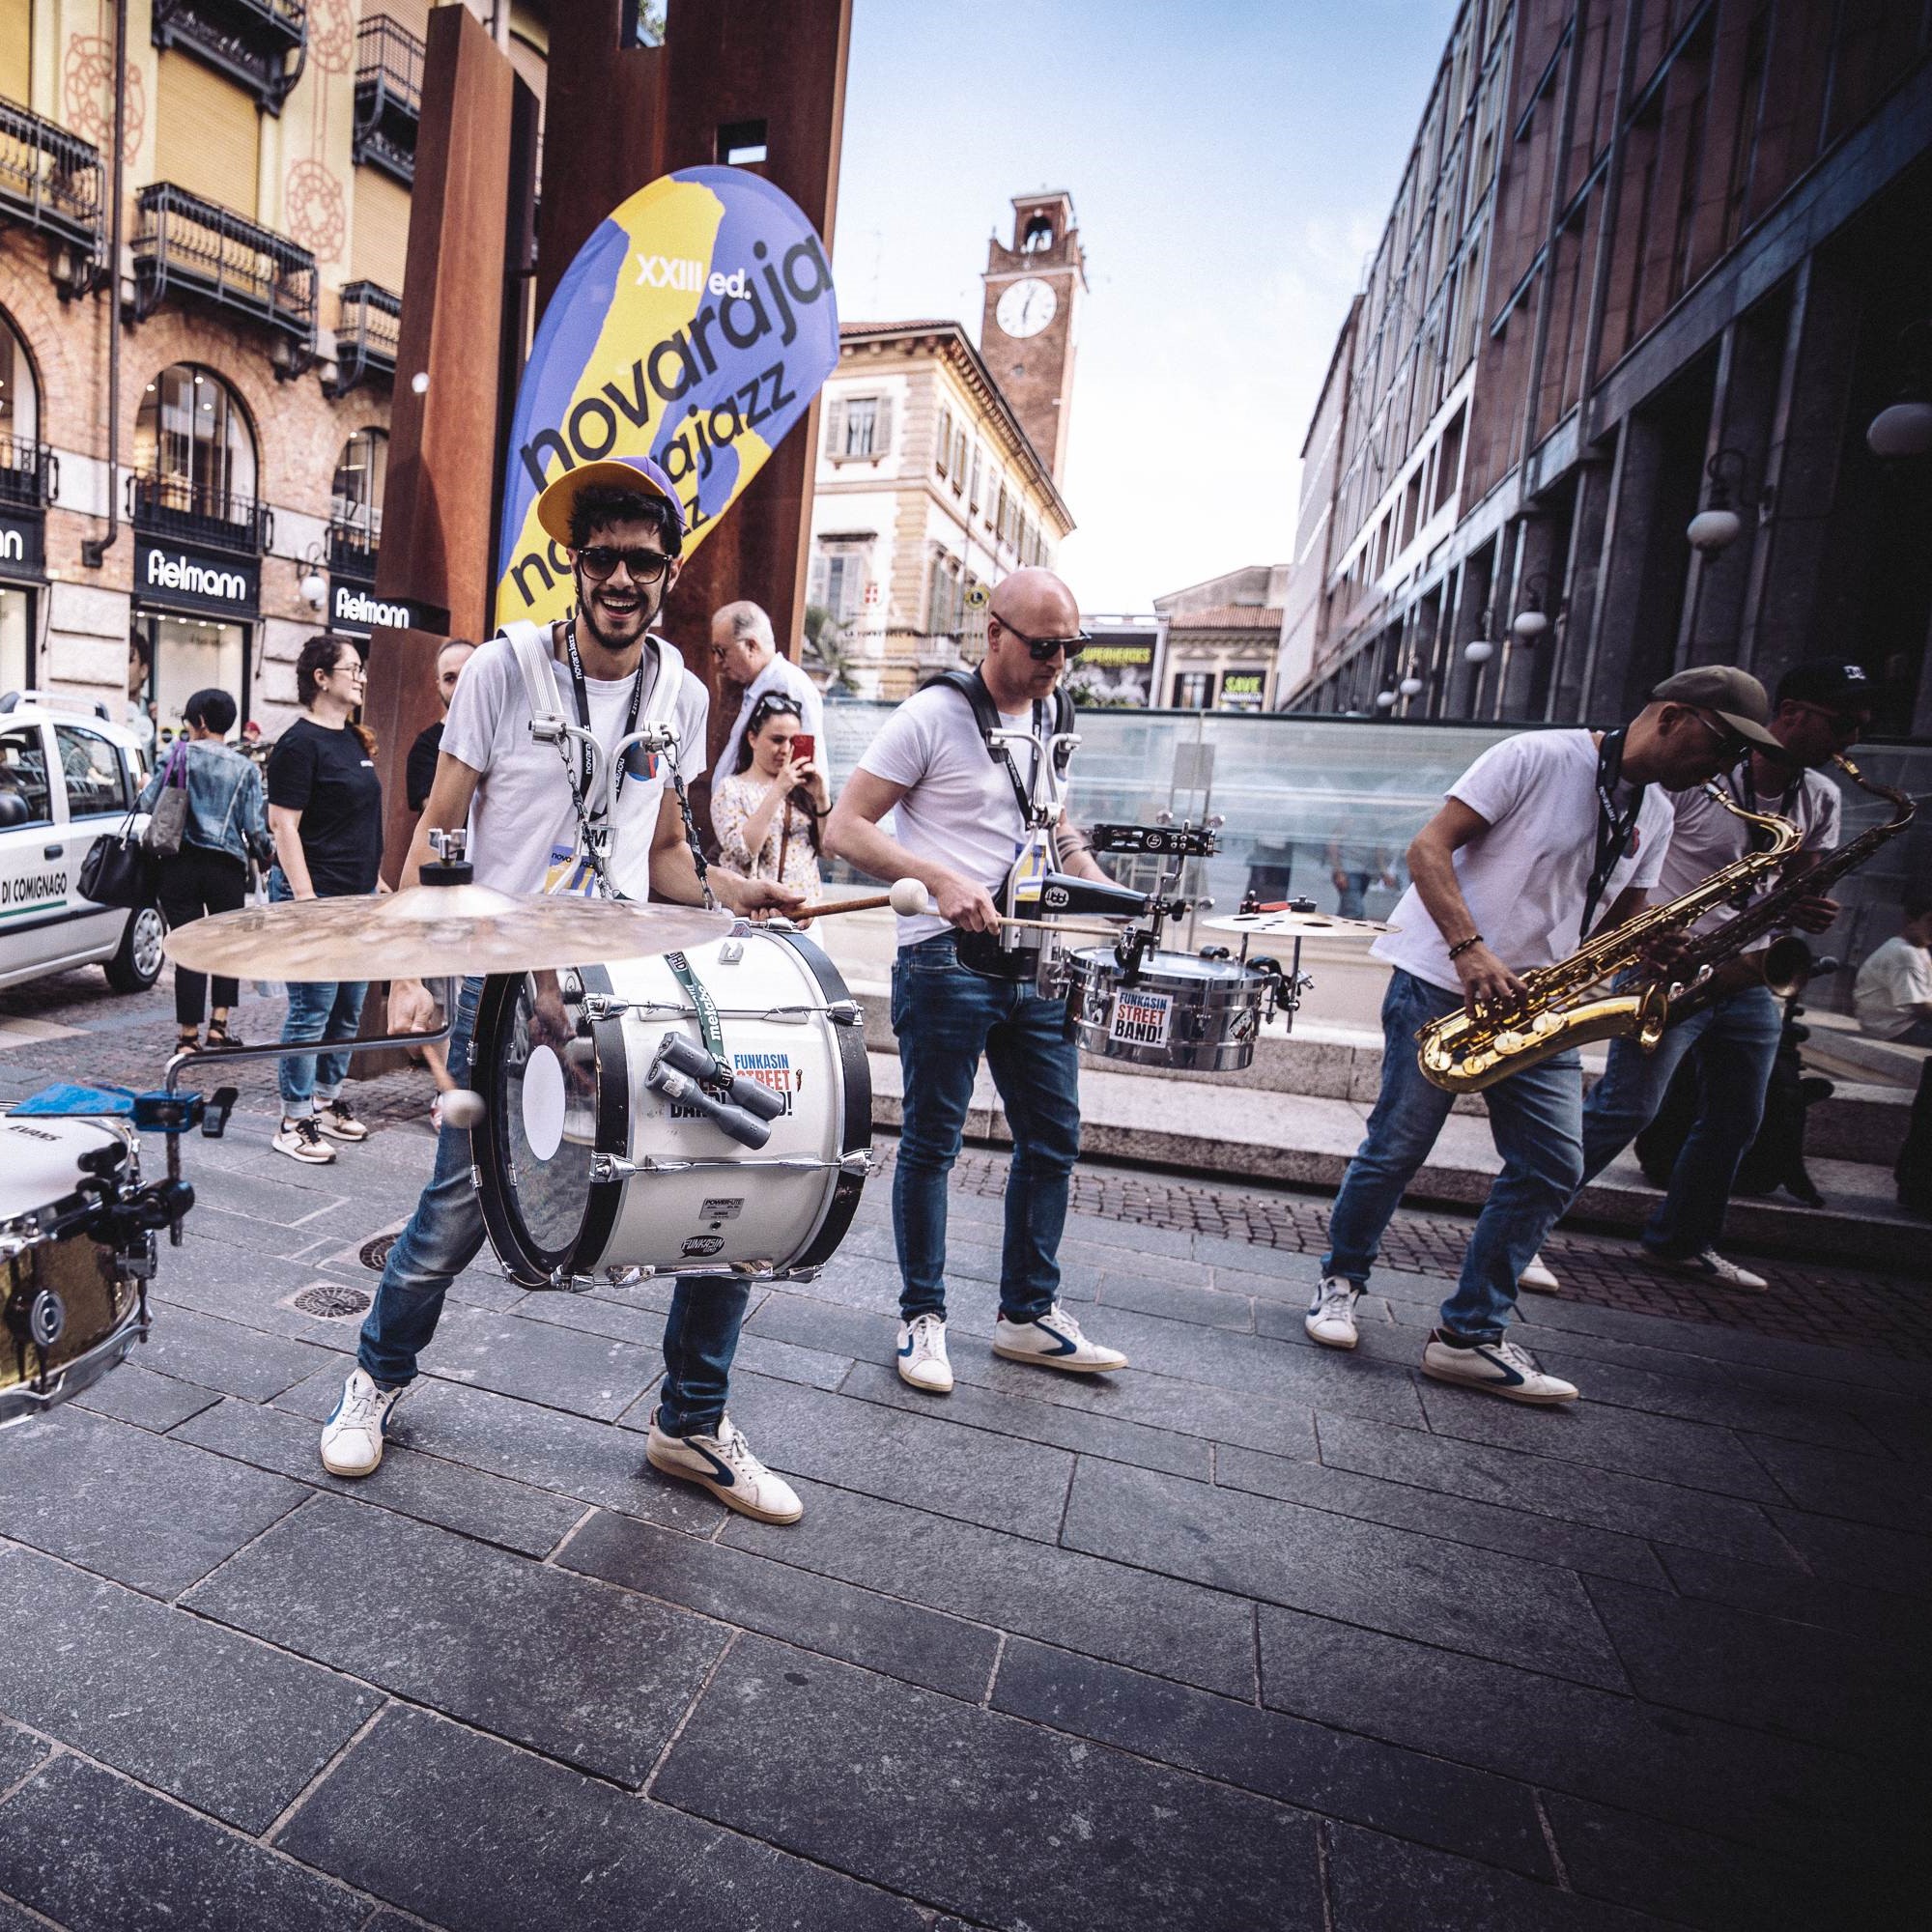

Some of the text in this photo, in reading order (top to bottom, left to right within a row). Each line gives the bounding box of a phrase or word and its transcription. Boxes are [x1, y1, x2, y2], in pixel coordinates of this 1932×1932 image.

[636, 253, 753, 299] XXIII ed.
[1225, 676, 1262, 693] SAVE
[2, 872, 68, 904] DI COMIGNAGO
[1119, 992, 1168, 1009] FUNKASIN
[697, 985, 722, 1040] metabo
[1117, 1005, 1166, 1026] STREET
[1114, 1019, 1163, 1044] BAND!
[733, 1054, 789, 1069] FUNKASIN
[9, 1124, 63, 1142] EVANS
